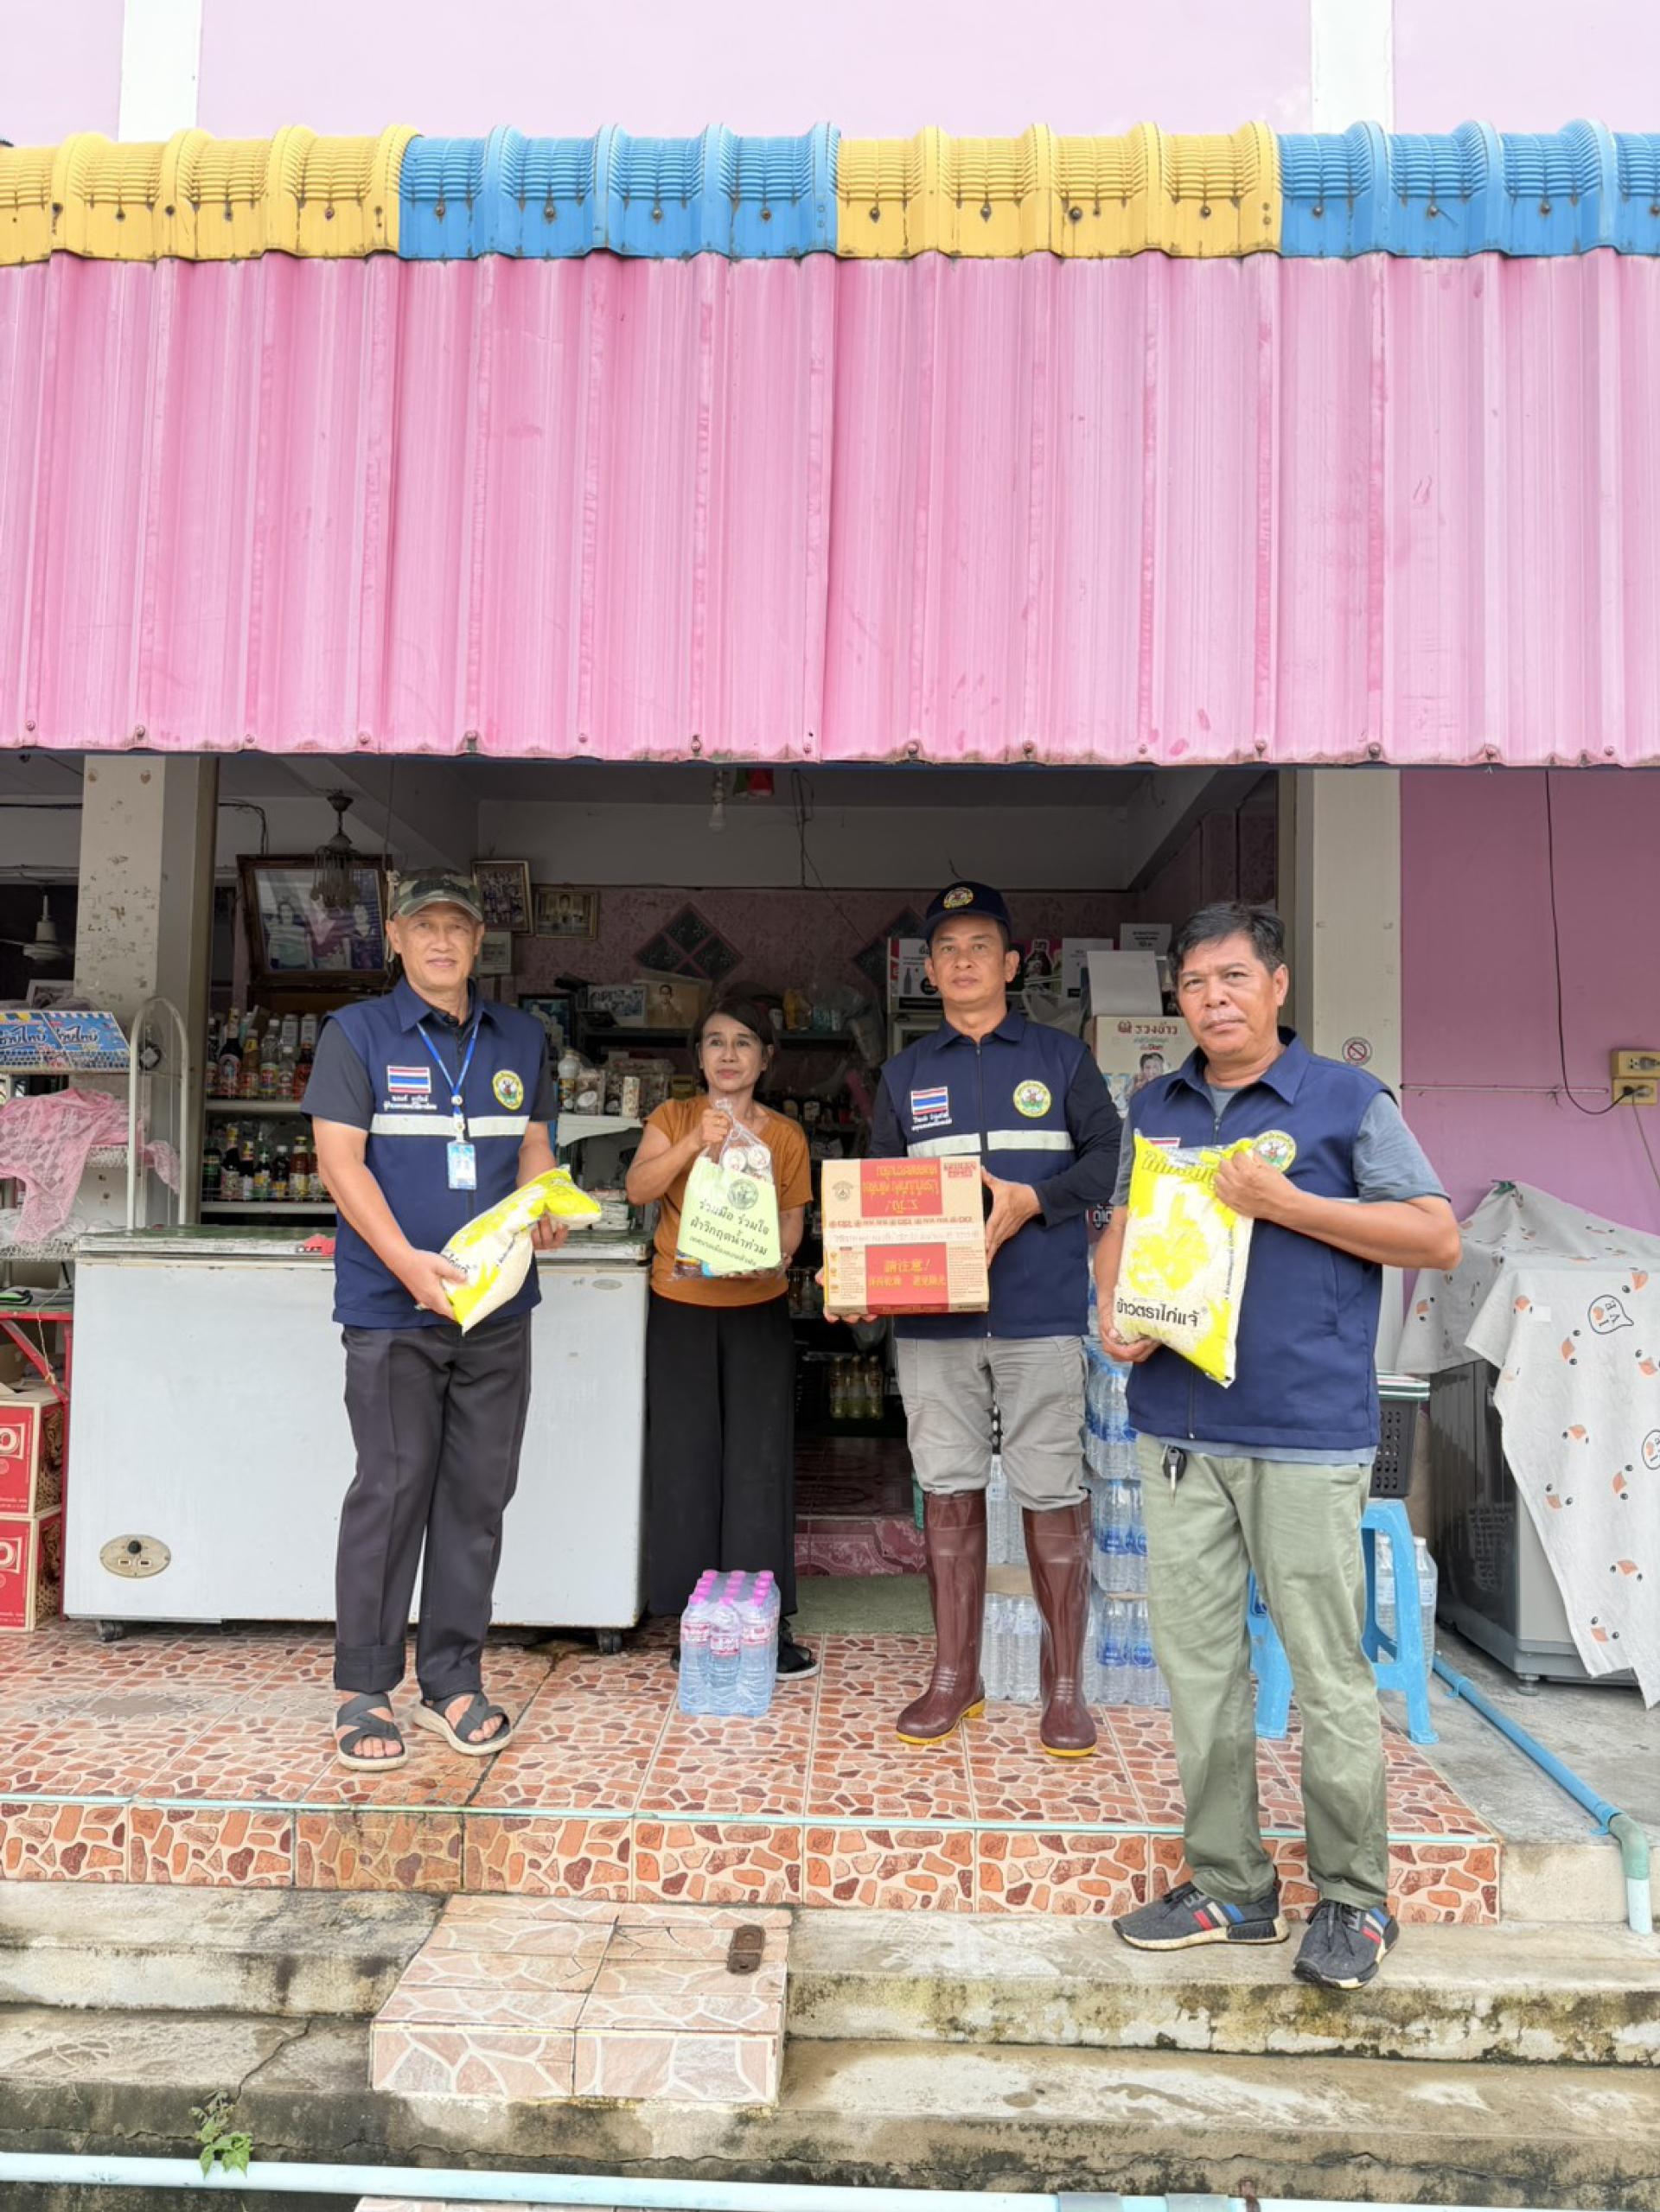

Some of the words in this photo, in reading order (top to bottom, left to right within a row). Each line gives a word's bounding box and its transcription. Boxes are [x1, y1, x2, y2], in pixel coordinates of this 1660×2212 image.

[699, 1199, 734, 1221] ร่วมมือ
[737, 1214, 769, 1235] ร่วมใจ
[1117, 1299, 1199, 1328] ข้าวตราไก่แจ้
